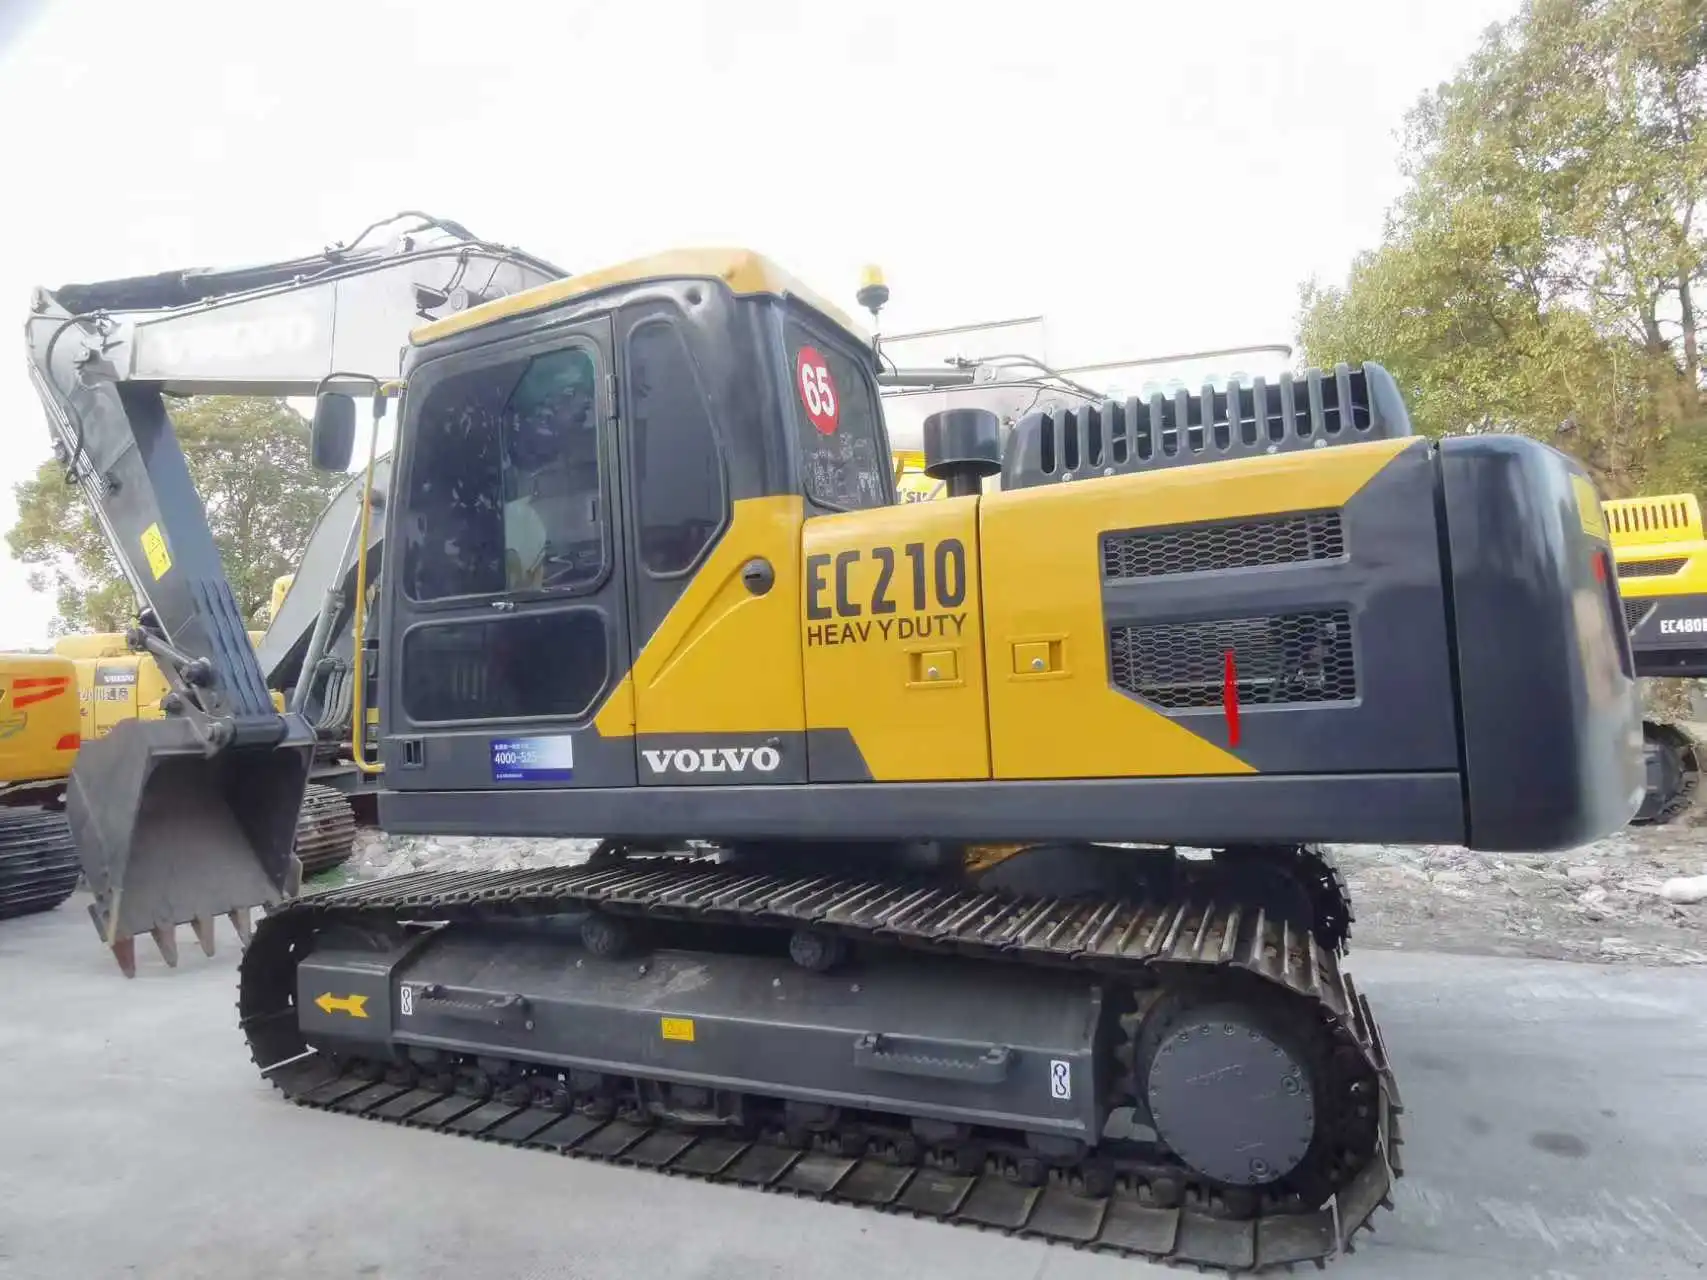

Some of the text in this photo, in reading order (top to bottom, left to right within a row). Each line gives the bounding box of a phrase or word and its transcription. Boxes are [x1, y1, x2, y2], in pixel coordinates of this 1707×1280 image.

[802, 363, 835, 417] 65
[806, 538, 966, 620] EC210
[807, 612, 967, 647] HEAVY DUTY
[641, 746, 780, 774] VOLVO
